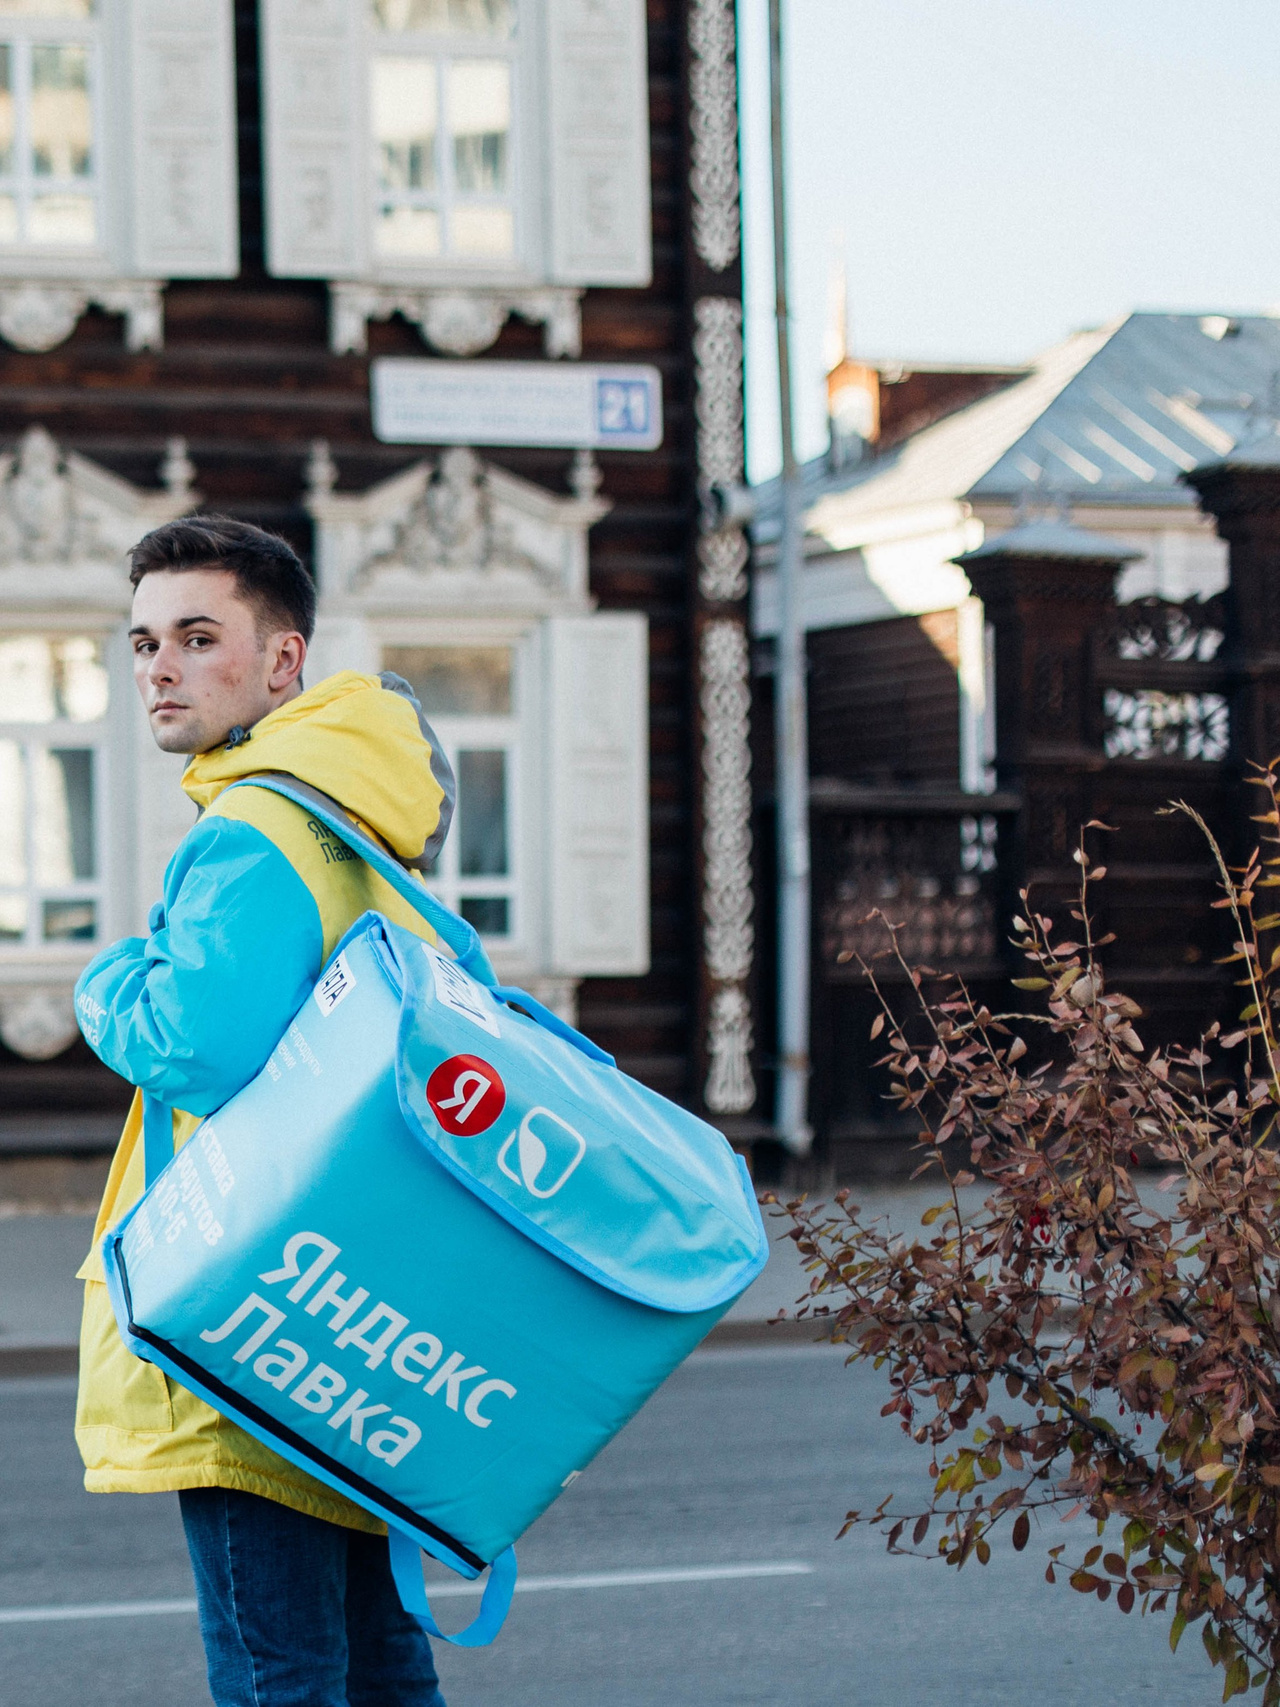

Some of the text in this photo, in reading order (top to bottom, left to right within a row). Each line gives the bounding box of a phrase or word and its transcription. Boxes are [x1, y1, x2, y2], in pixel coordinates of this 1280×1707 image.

[602, 384, 646, 430] 21
[320, 842, 357, 864] Лав
[266, 1057, 282, 1082] авка
[437, 1070, 492, 1124] Я
[197, 1119, 235, 1197] оставка
[176, 1149, 224, 1246] родуктов
[257, 1231, 517, 1429] Яндекс
[199, 1292, 423, 1468] Лавка
